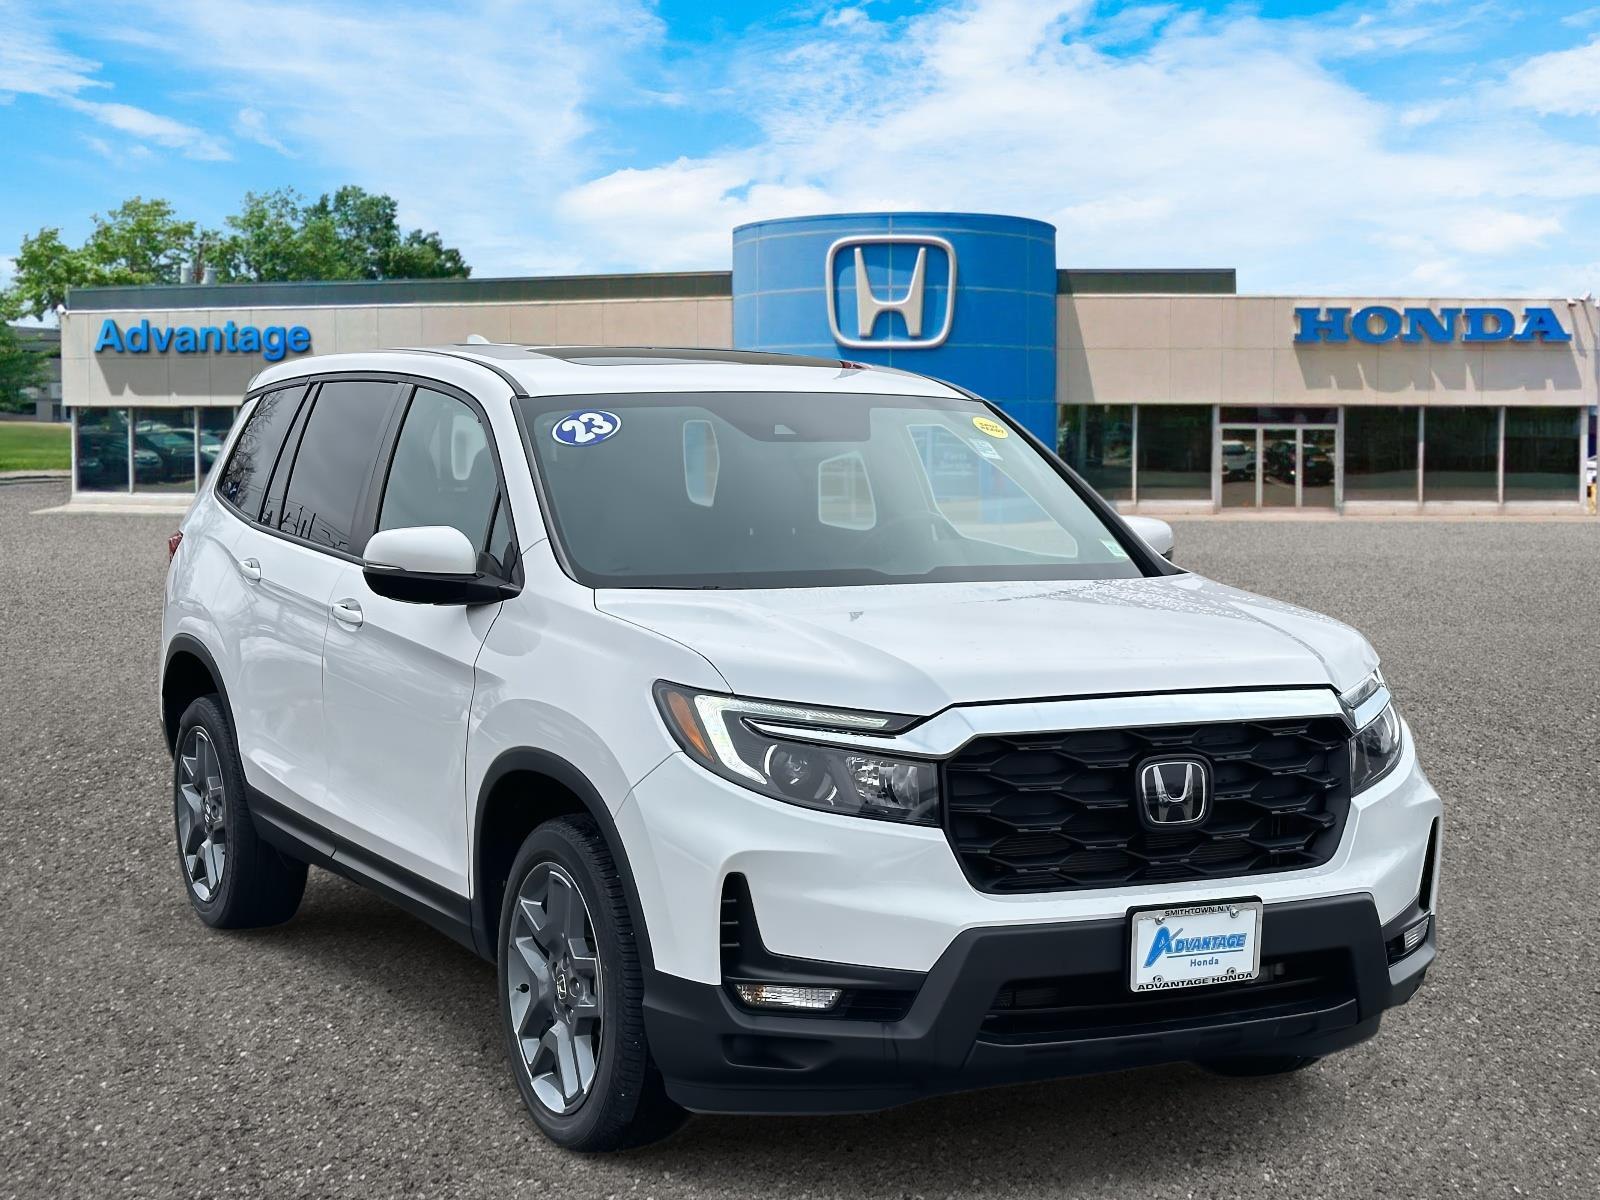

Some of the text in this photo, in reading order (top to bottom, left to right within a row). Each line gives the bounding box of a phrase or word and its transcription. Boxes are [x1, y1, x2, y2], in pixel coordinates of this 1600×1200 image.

[94, 318, 311, 362] Advantage
[1293, 306, 1572, 343] HONDA
[561, 412, 613, 443] 23
[1143, 927, 1247, 968] ADVANTAGE
[1190, 957, 1219, 967] Honda
[1137, 973, 1253, 990] ADVANTAGE HONDA
